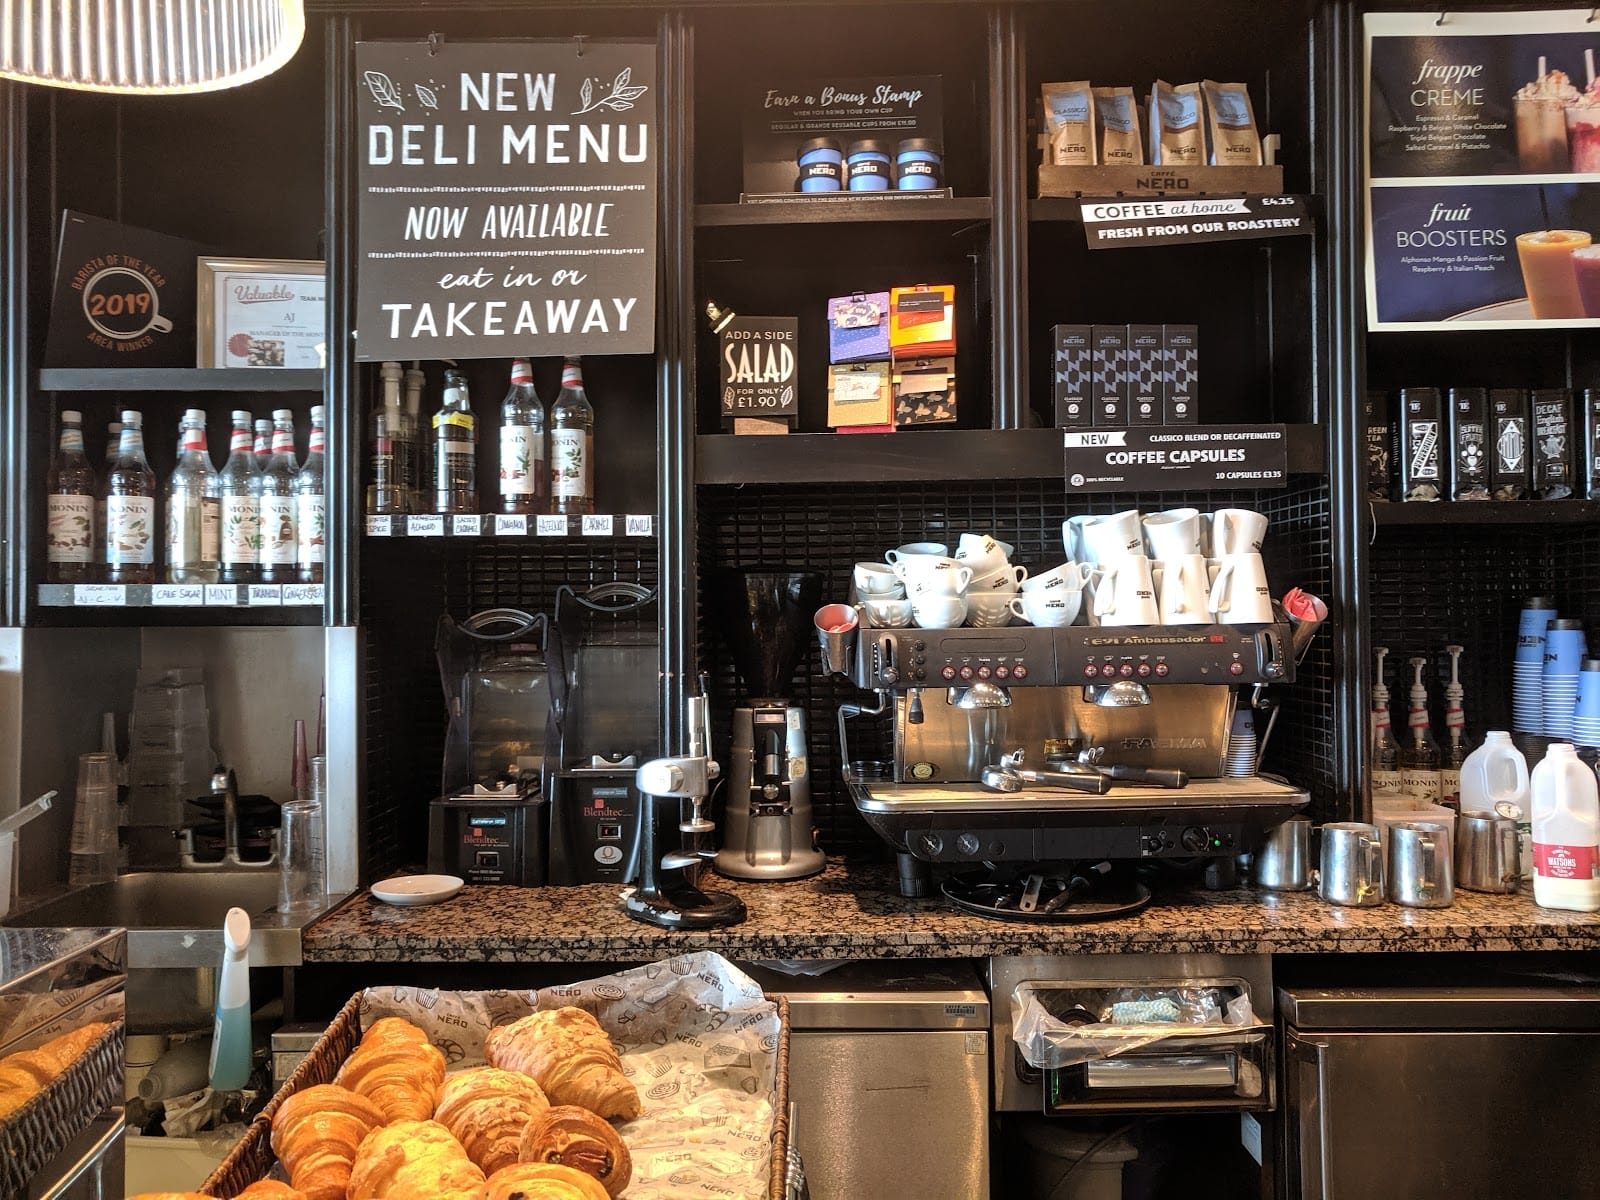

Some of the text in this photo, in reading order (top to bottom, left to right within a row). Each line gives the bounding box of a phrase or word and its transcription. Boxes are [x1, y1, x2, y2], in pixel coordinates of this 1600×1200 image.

[1412, 58, 1483, 85] frappe
[460, 72, 556, 112] NEW
[764, 84, 923, 109] Earn a Bonus Stamp
[1410, 86, 1485, 107] CRÈME
[1054, 107, 1087, 115] CLASSICO
[1415, 114, 1445, 122] Espresso
[1451, 113, 1479, 121] Caramel
[831, 121, 861, 129] REUSABLE
[1388, 124, 1420, 132] Raspberry
[1428, 123, 1452, 132] Belgian
[1473, 122, 1507, 130] Chocolate
[1428, 133, 1452, 141] Belgian
[369, 124, 647, 165] DELI MENU
[1426, 143, 1454, 151] Caramel
[1461, 142, 1491, 150] Pistachio
[1108, 151, 1132, 159] NERO
[1170, 147, 1196, 155] NERO
[809, 168, 835, 176] NERO
[852, 165, 878, 175] NERO
[905, 166, 932, 174] NERO
[1136, 178, 1189, 190] NERO
[1094, 197, 1295, 220] COFFEE at home £4.25
[1423, 202, 1473, 228] fruit
[404, 203, 615, 240] NOW AVAILABLE
[1098, 217, 1301, 240] FRESH FROM OUR ROASTERY
[1397, 229, 1507, 248] BOOSTERS
[1400, 256, 1432, 264] Alphonso
[72, 254, 167, 290] BARISTA OF THE YEAR
[1412, 265, 1445, 273] Raspberry
[436, 265, 588, 289] eat in or
[234, 285, 296, 302] Valuable
[90, 292, 151, 316] 2019
[283, 312, 296, 322] AJ
[381, 298, 637, 339] TAKEAWAY
[725, 331, 793, 340] ADD A SIDE
[86, 332, 155, 352] AREA WINNER
[724, 343, 794, 384] SALAD
[738, 396, 777, 408] £1.90
[1535, 404, 1563, 415] DECAF
[1536, 413, 1564, 427] English
[1367, 426, 1388, 434] REEN
[552, 439, 579, 447] ONIN
[1081, 434, 1110, 445] NEW
[1149, 432, 1281, 443] CLASSICO BLEND OR DECAFFEINATED
[1105, 449, 1245, 465] COFFEE CAPSULES
[1216, 472, 1225, 480] 10
[1226, 471, 1261, 480] CAPSULES
[49, 504, 89, 512] MONIN
[1045, 579, 1064, 589] NERO
[208, 589, 233, 600] MINT
[1123, 636, 1206, 645] Ambassador
[584, 806, 623, 817] Blendtec
[463, 834, 499, 844] Blendtec
[1547, 857, 1576, 867] WATSONS
[696, 972, 725, 992] NERO
[550, 988, 582, 997] NERO
[437, 1014, 468, 1029] NERO
[734, 1012, 764, 1034] NERO
[674, 1033, 702, 1048] NERO
[727, 1129, 762, 1142] NERO
